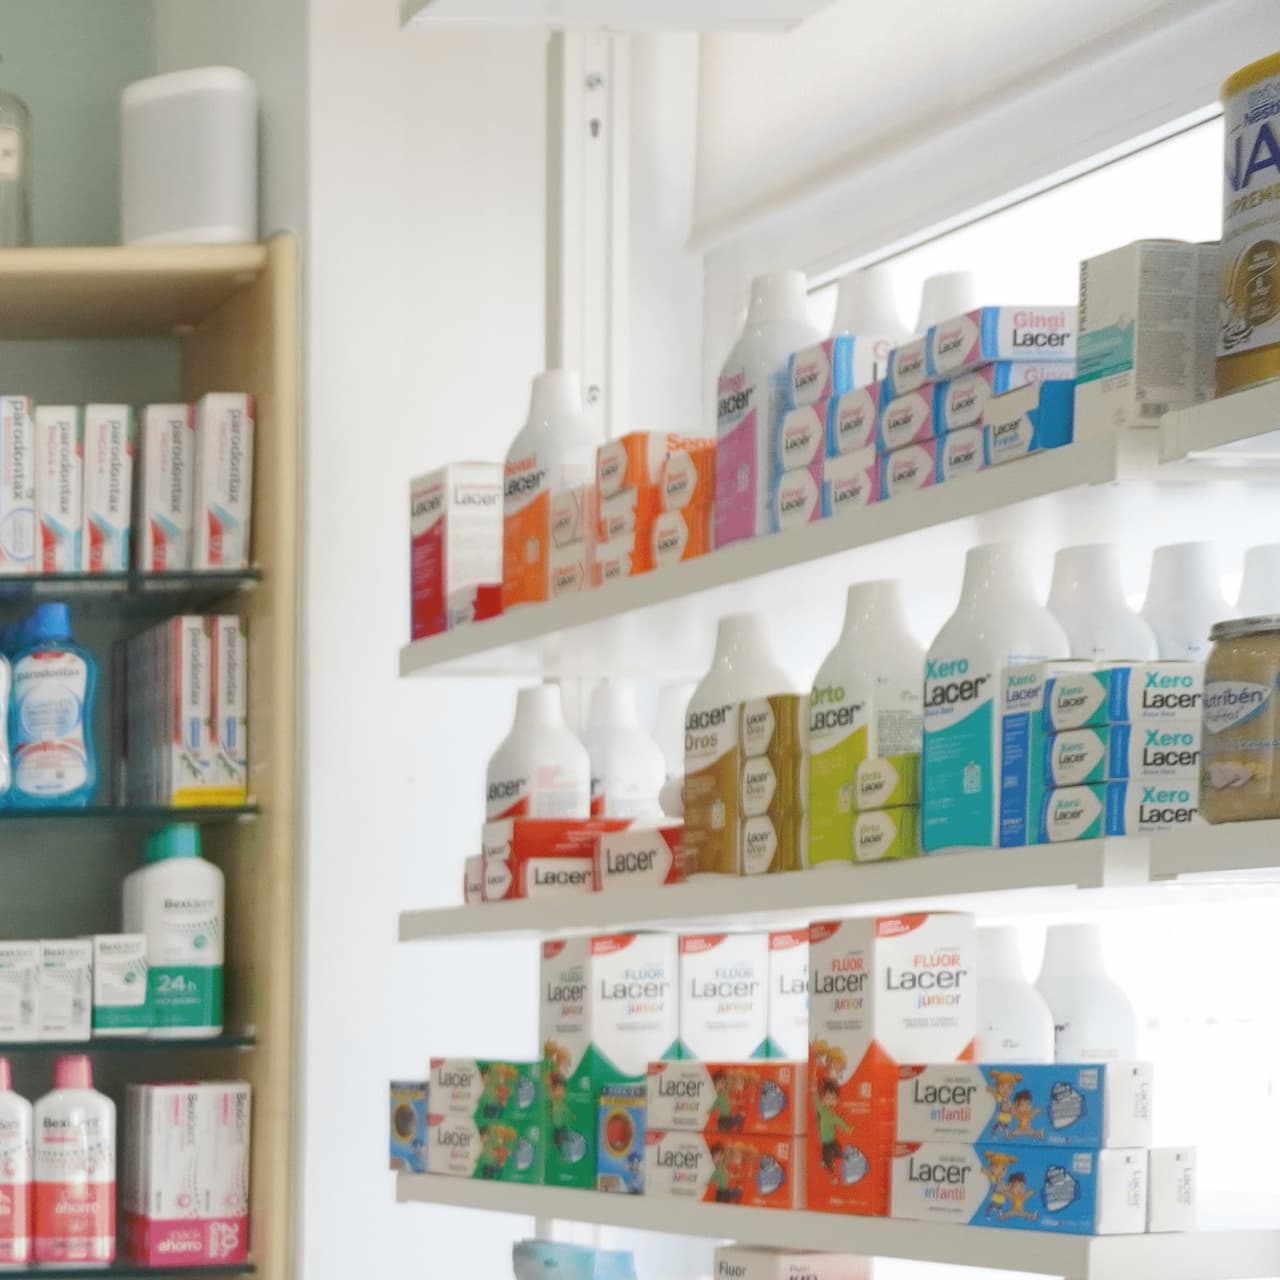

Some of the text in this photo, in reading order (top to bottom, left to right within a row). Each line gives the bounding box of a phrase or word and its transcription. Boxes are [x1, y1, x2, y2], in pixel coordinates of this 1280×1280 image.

[1012, 310, 1066, 329] Gingi
[1012, 329, 1071, 348] Lacer
[992, 416, 1022, 438] Lacer
[9, 400, 24, 501] parodontax
[228, 408, 243, 505] parodontax
[59, 420, 73, 515] parodontax
[108, 419, 122, 514] parodontax
[170, 419, 185, 514] parodontax
[454, 486, 501, 506] Lacer
[16, 666, 80, 682] parodontax
[190, 626, 201, 706] parodontax
[225, 626, 237, 705] parodontax
[926, 658, 970, 681] Xero
[1007, 673, 1037, 687] Xero
[1146, 670, 1194, 689] Xero
[923, 677, 986, 708] Lacer
[1006, 684, 1041, 702] Lacer
[1143, 690, 1203, 709] Lacer
[1146, 730, 1194, 747] Xero
[1143, 748, 1201, 767] Lacer
[1142, 786, 1190, 804] Xero
[1139, 804, 1198, 824] Lacer
[606, 850, 657, 875] Lacer
[534, 867, 593, 885] Lacer
[158, 974, 186, 993] 24
[691, 978, 760, 999] Lacer
[813, 972, 868, 994] Lacer
[886, 968, 968, 991] Lacer
[547, 983, 587, 1003] Lacer
[600, 980, 670, 1000] Lacer
[438, 1069, 474, 1089] Lacer
[658, 1073, 705, 1098] Lacer
[913, 1080, 977, 1106] Lacer
[930, 1107, 972, 1122] infantil
[438, 1127, 474, 1147] Lacer
[656, 1146, 702, 1169] Lacer
[909, 1157, 972, 1185] Lacer
[925, 1185, 966, 1201] infantil
[158, 1238, 203, 1254] ahorro
[719, 1261, 747, 1278] Fluor
